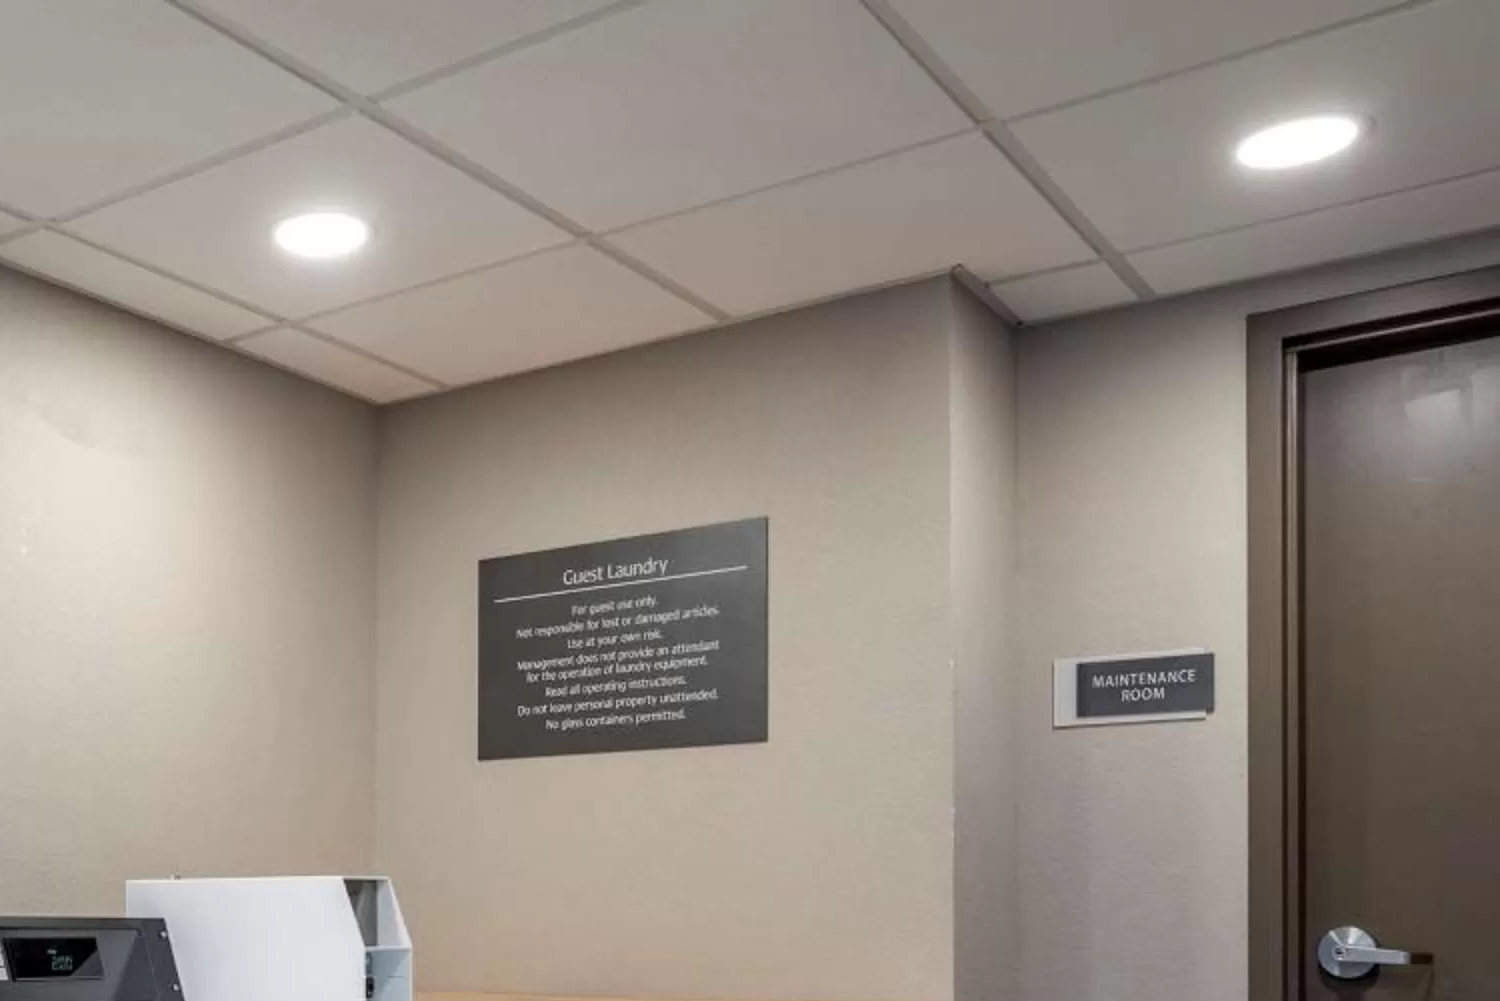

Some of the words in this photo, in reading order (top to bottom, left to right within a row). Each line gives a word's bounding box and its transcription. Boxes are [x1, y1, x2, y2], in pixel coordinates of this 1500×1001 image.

[562, 567, 603, 586] Guest
[606, 556, 669, 579] Laundry
[571, 605, 586, 617] For
[589, 601, 615, 616] guest
[516, 627, 533, 639] Not
[534, 620, 584, 638] responsible
[586, 618, 600, 631] for
[601, 616, 620, 629] lost
[621, 617, 632, 626] or
[634, 610, 681, 626] damaged
[567, 639, 583, 649] Use
[584, 638, 596, 647] at
[597, 635, 618, 650] your
[620, 633, 642, 643] own
[517, 656, 575, 672] Management
[575, 654, 599, 666] does
[600, 651, 616, 662] not
[617, 647, 654, 663] provide
[656, 647, 670, 657] an
[671, 639, 720, 655] attendant
[525, 671, 540, 683] for
[541, 670, 557, 681] the
[558, 667, 602, 682] operation
[603, 663, 615, 675] of
[615, 660, 651, 675] laundry
[1092, 669, 1196, 688] MAINTENANCE
[545, 686, 568, 698] Read
[569, 683, 581, 695] all
[581, 680, 627, 697] operating
[1121, 687, 1165, 702] ROOM
[517, 705, 531, 717] Do
[531, 704, 547, 715] not
[548, 702, 573, 713] leave
[573, 699, 613, 714] personal
[615, 695, 658, 710] property
[545, 719, 560, 730] No
[561, 718, 584, 732] glass
[584, 714, 634, 728] containers
